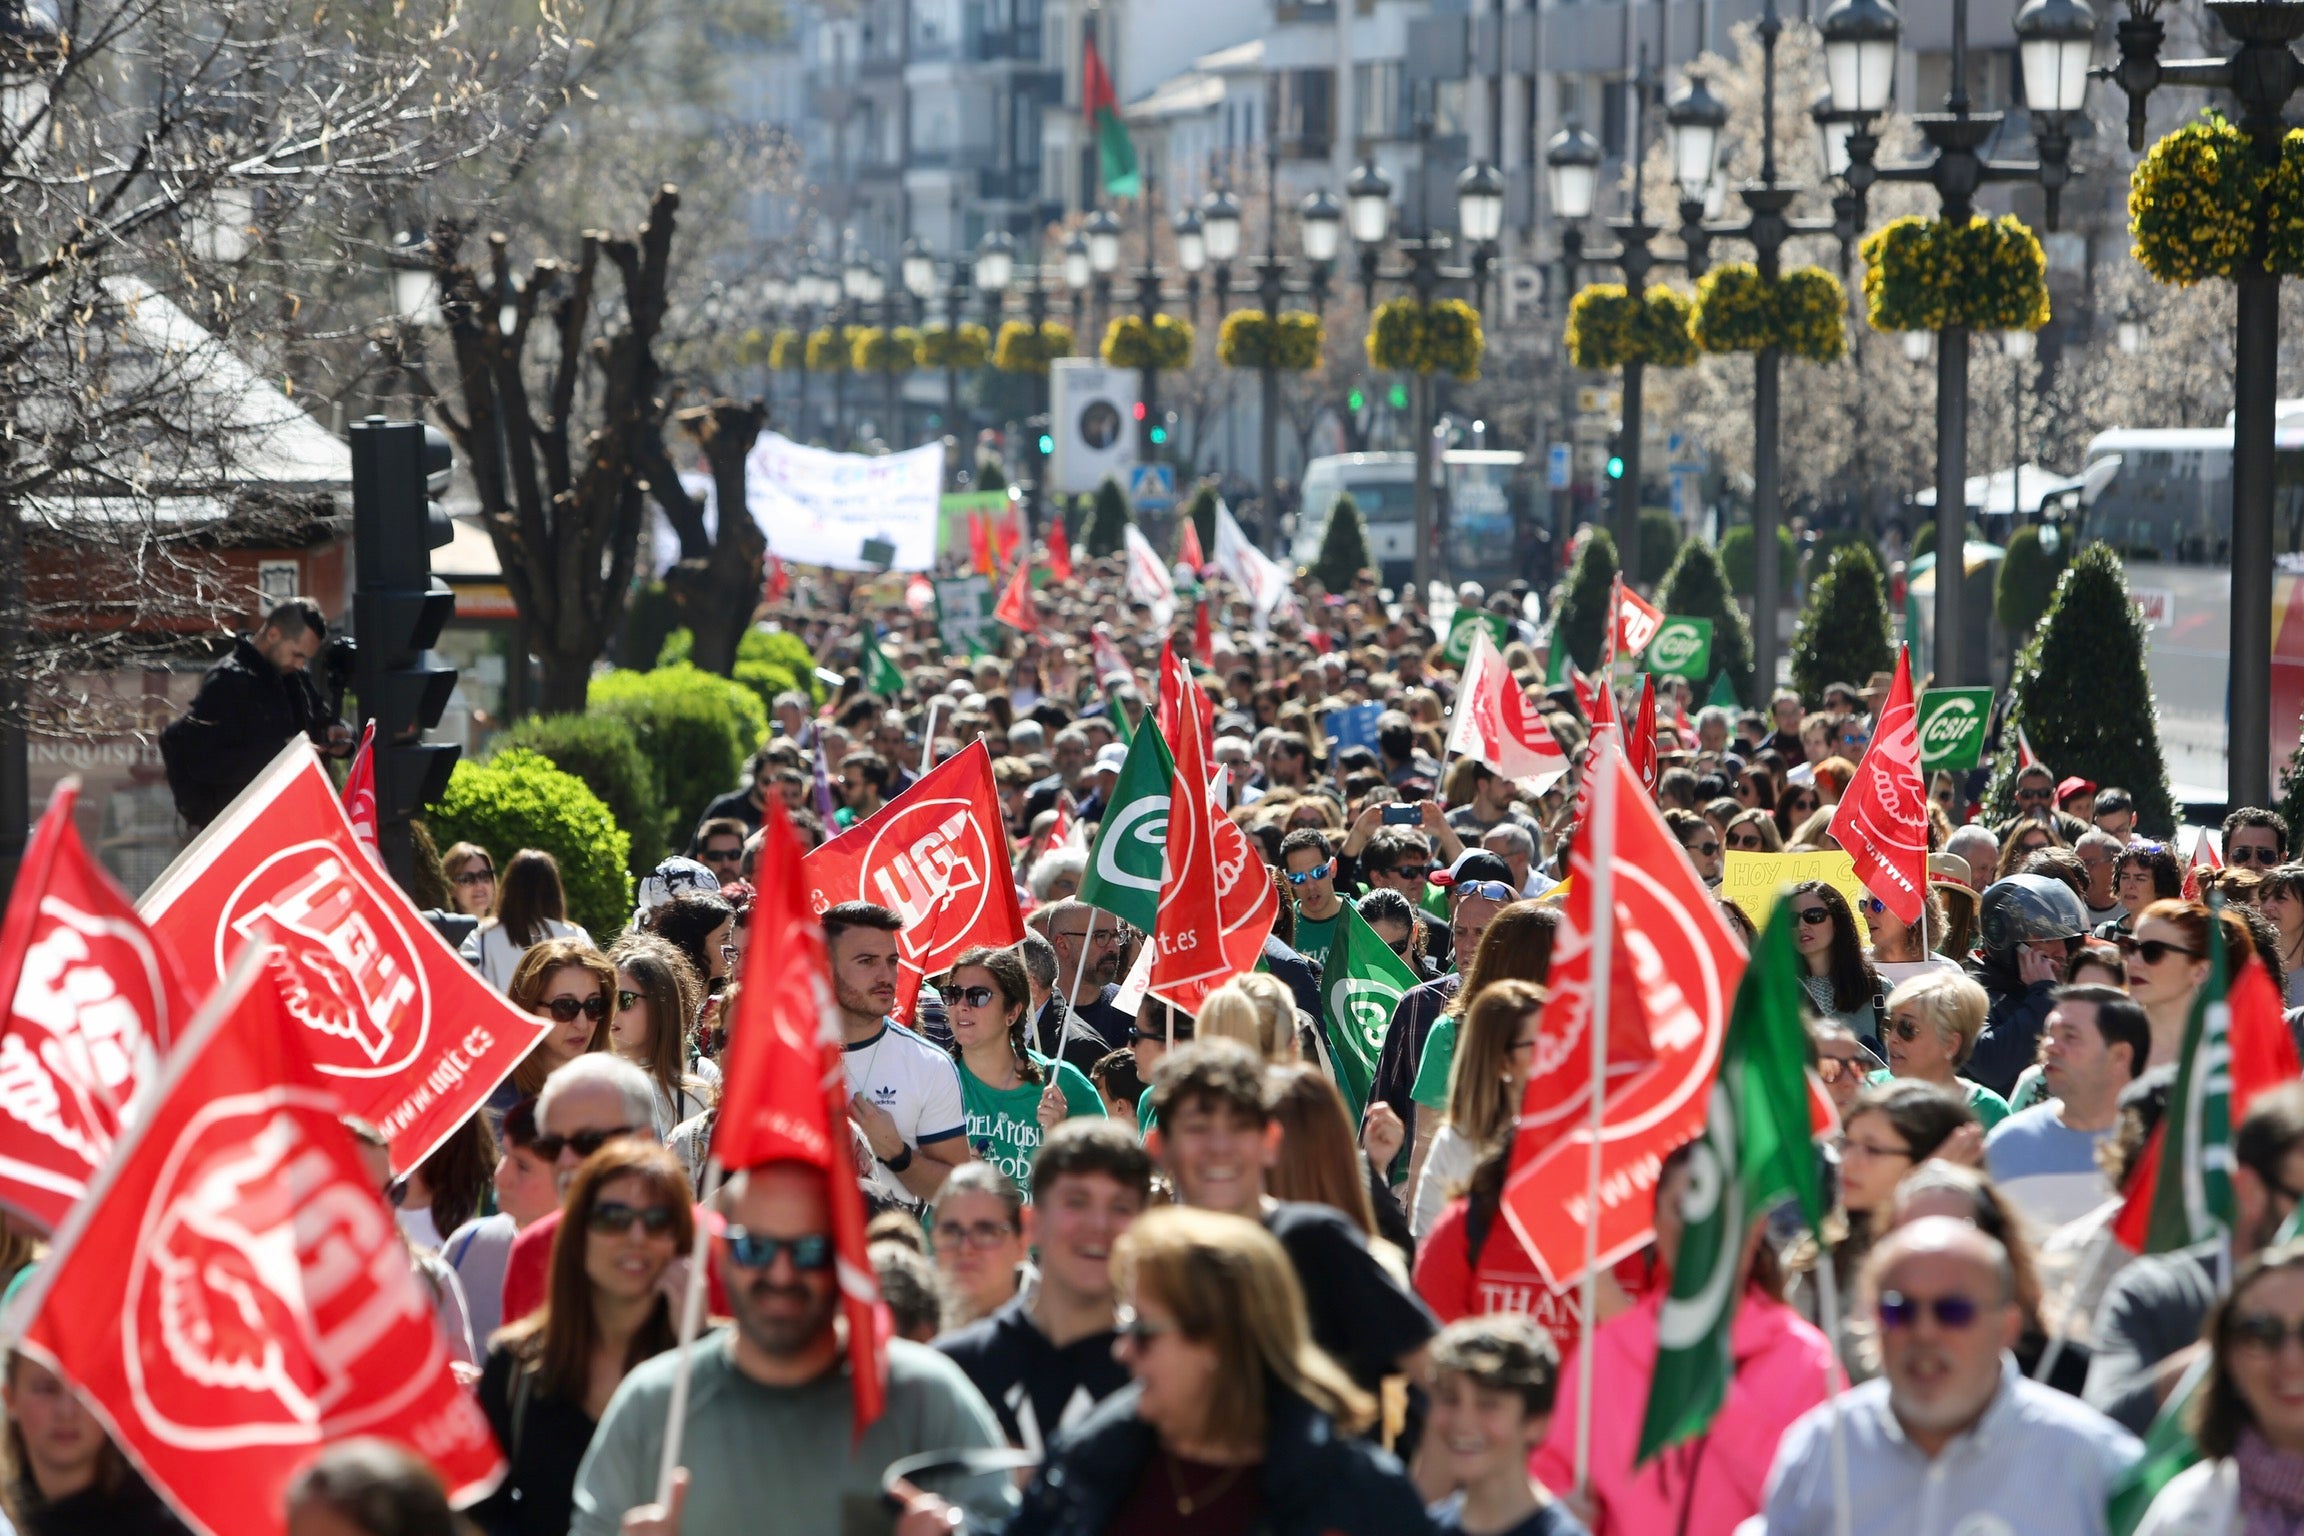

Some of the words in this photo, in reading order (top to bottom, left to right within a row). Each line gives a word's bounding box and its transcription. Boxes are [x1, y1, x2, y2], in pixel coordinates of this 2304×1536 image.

[1502, 264, 1543, 325] P
[872, 808, 969, 927] UGT
[1733, 862, 1781, 887] HOY
[1791, 860, 1822, 883] LA
[270, 856, 417, 1028] UGT
[966, 1114, 1004, 1141] UELA
[1006, 1119, 1045, 1147] PÚBL
[984, 1156, 1032, 1179] TOD
[1480, 1283, 1584, 1325] THAN
